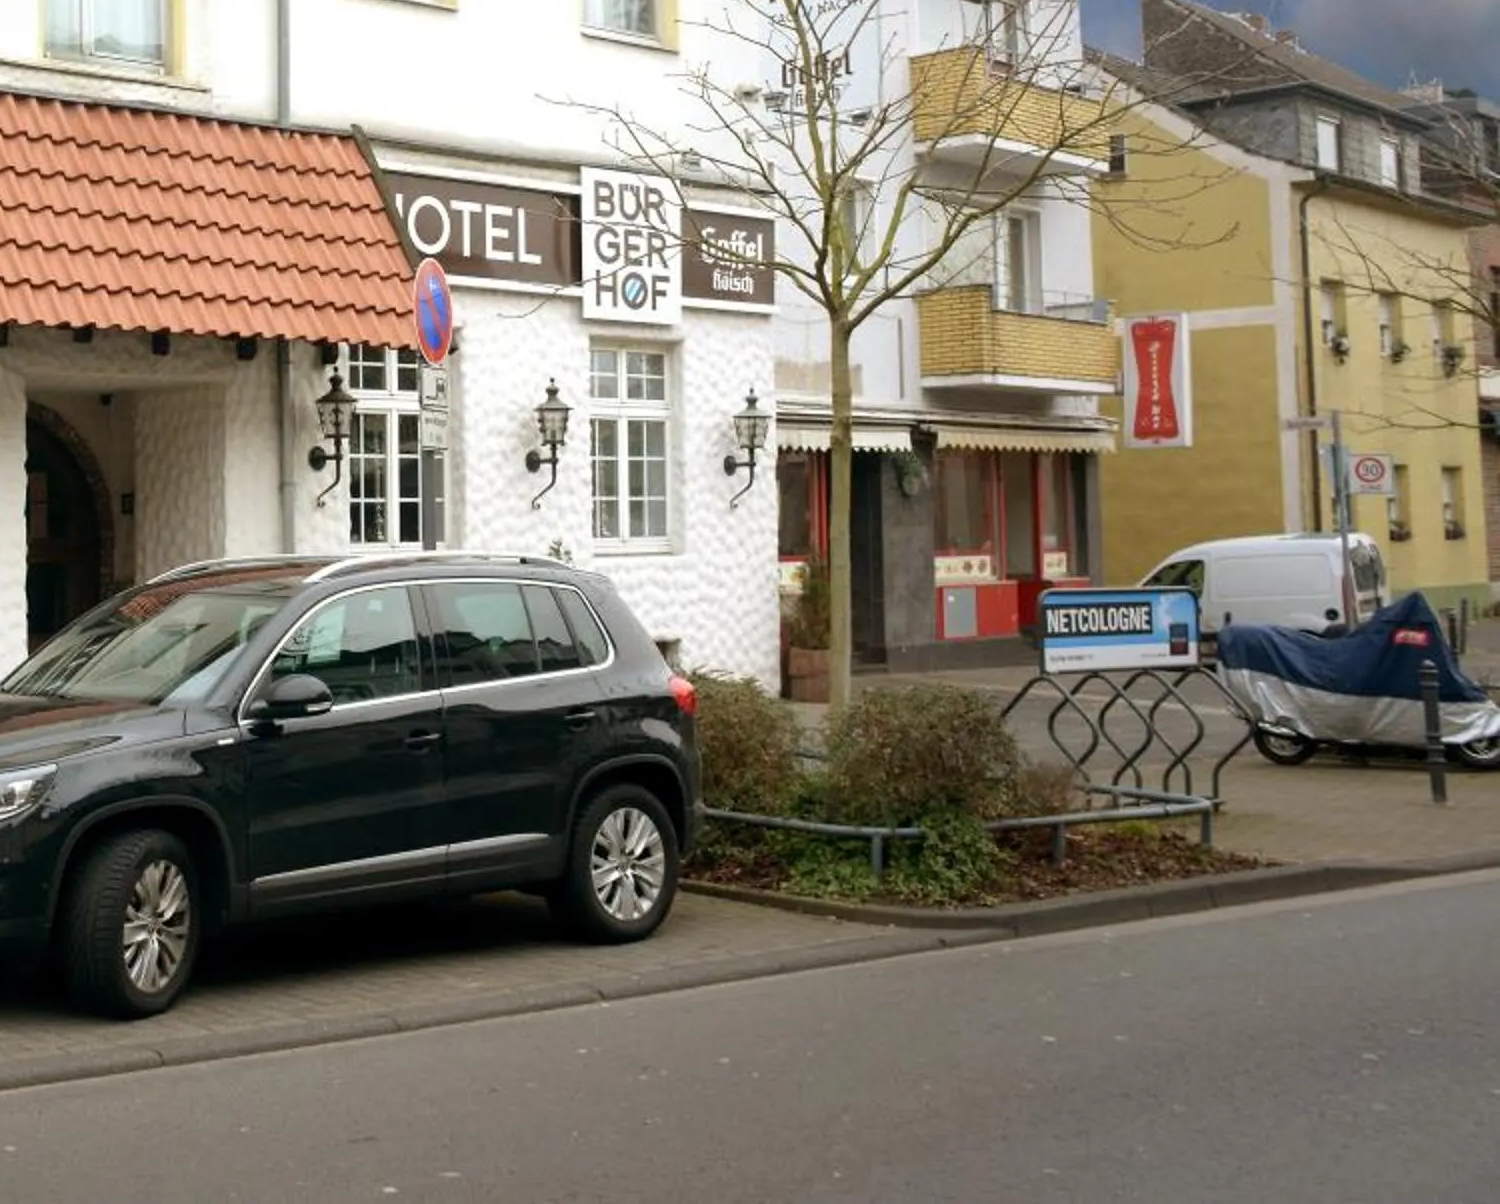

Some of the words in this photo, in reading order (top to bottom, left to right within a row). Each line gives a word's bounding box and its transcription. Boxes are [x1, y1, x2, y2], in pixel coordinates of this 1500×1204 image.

[593, 179, 668, 225] BÜR
[396, 193, 543, 266] OTEL
[593, 225, 669, 269] GER
[595, 269, 671, 311] HOF
[1046, 606, 1151, 634] NETCOLOGNE
